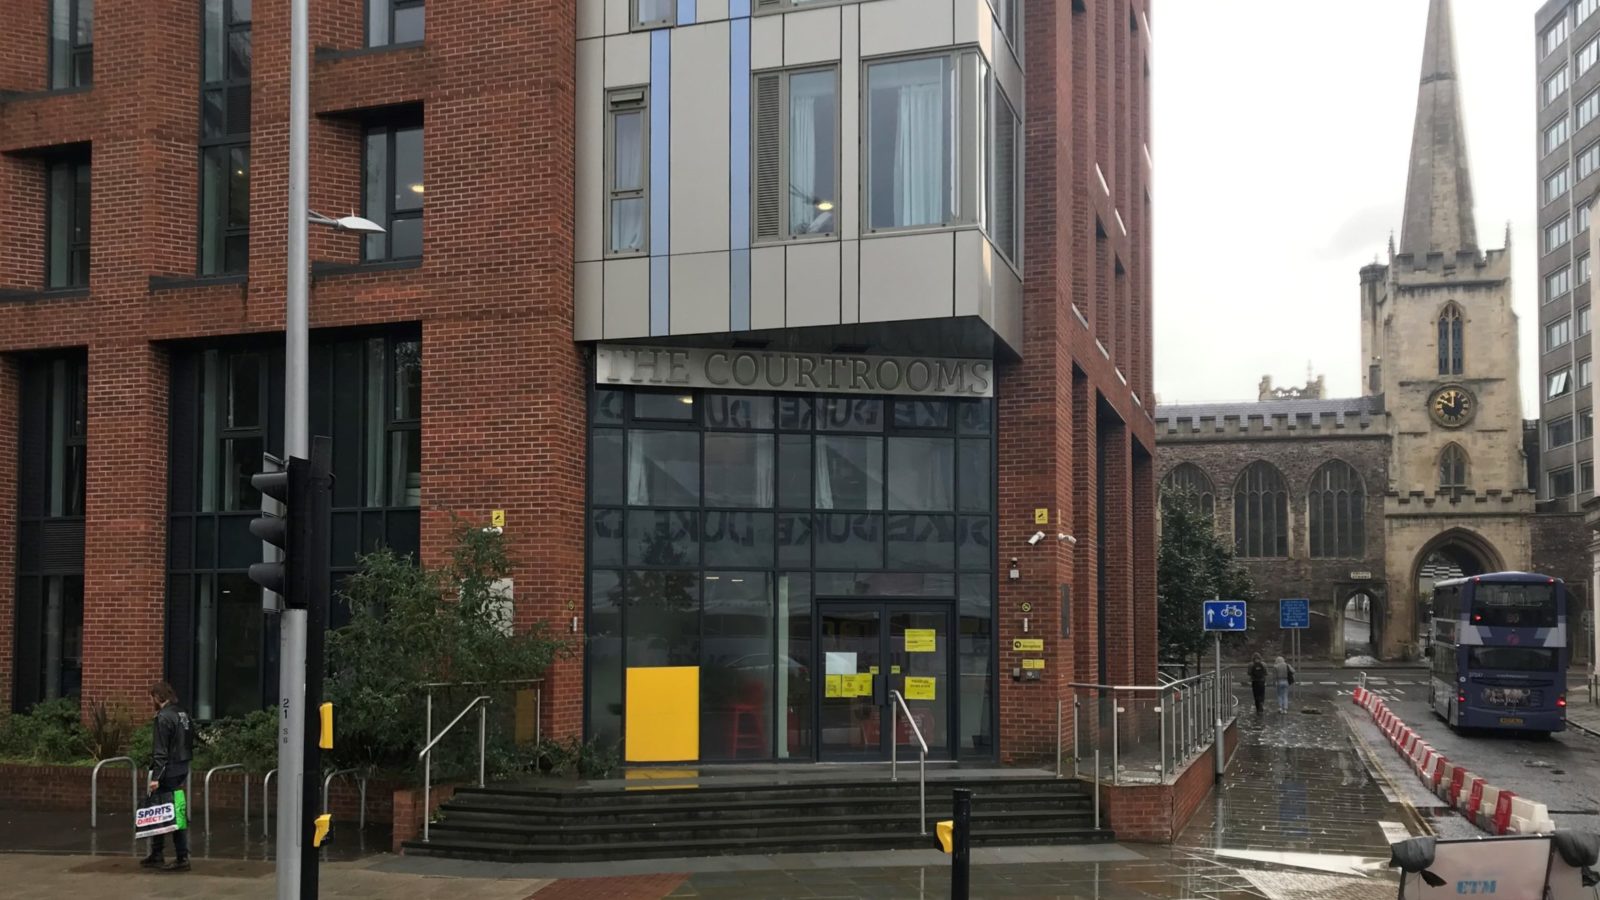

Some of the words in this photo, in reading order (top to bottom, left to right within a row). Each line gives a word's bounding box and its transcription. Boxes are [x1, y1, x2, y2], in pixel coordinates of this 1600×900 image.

[600, 349, 689, 384] THE
[704, 351, 990, 395] COURTROOMS
[138, 805, 172, 818] SPORTS
